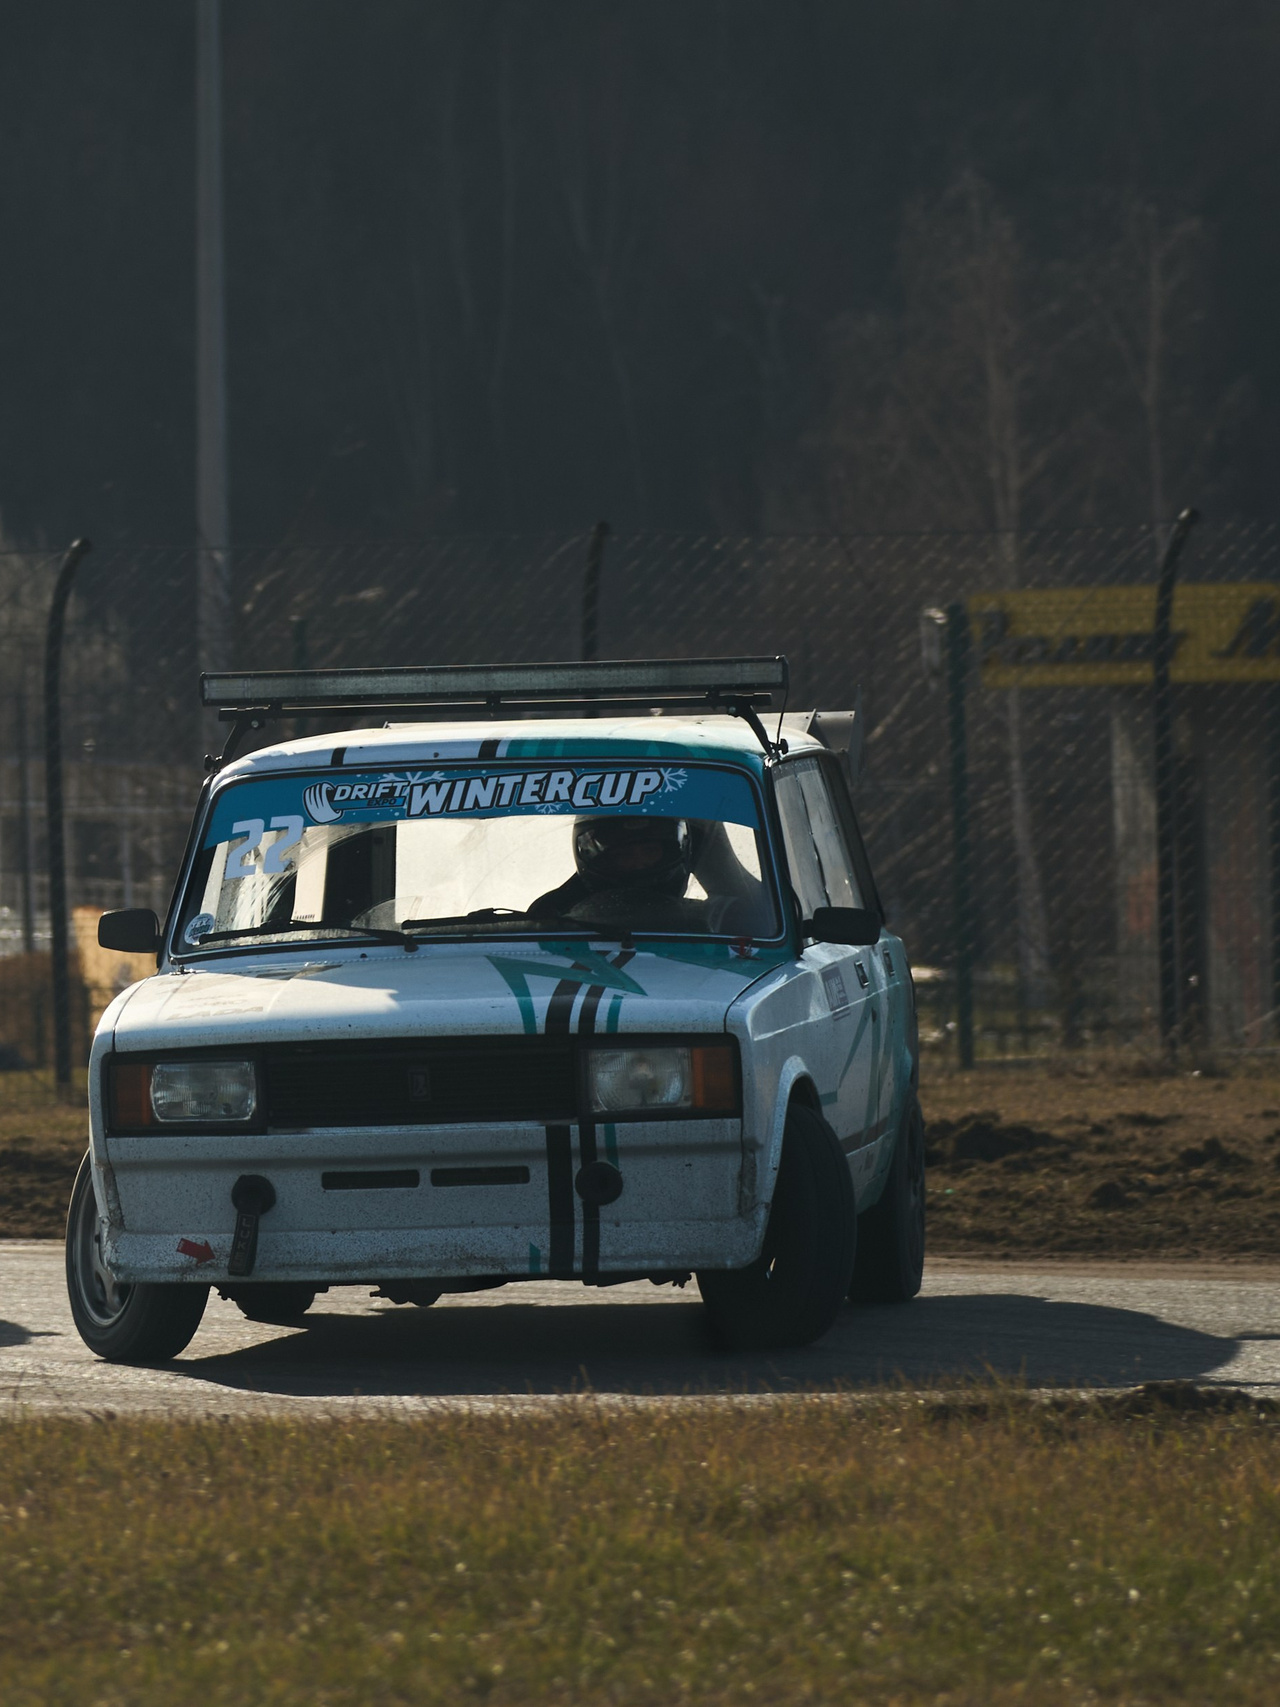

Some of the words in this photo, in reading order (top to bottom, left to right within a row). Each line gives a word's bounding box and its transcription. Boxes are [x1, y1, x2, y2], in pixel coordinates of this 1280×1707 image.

[333, 781, 410, 801] DRIFT
[366, 797, 398, 807] EXPO
[224, 814, 305, 880] 22
